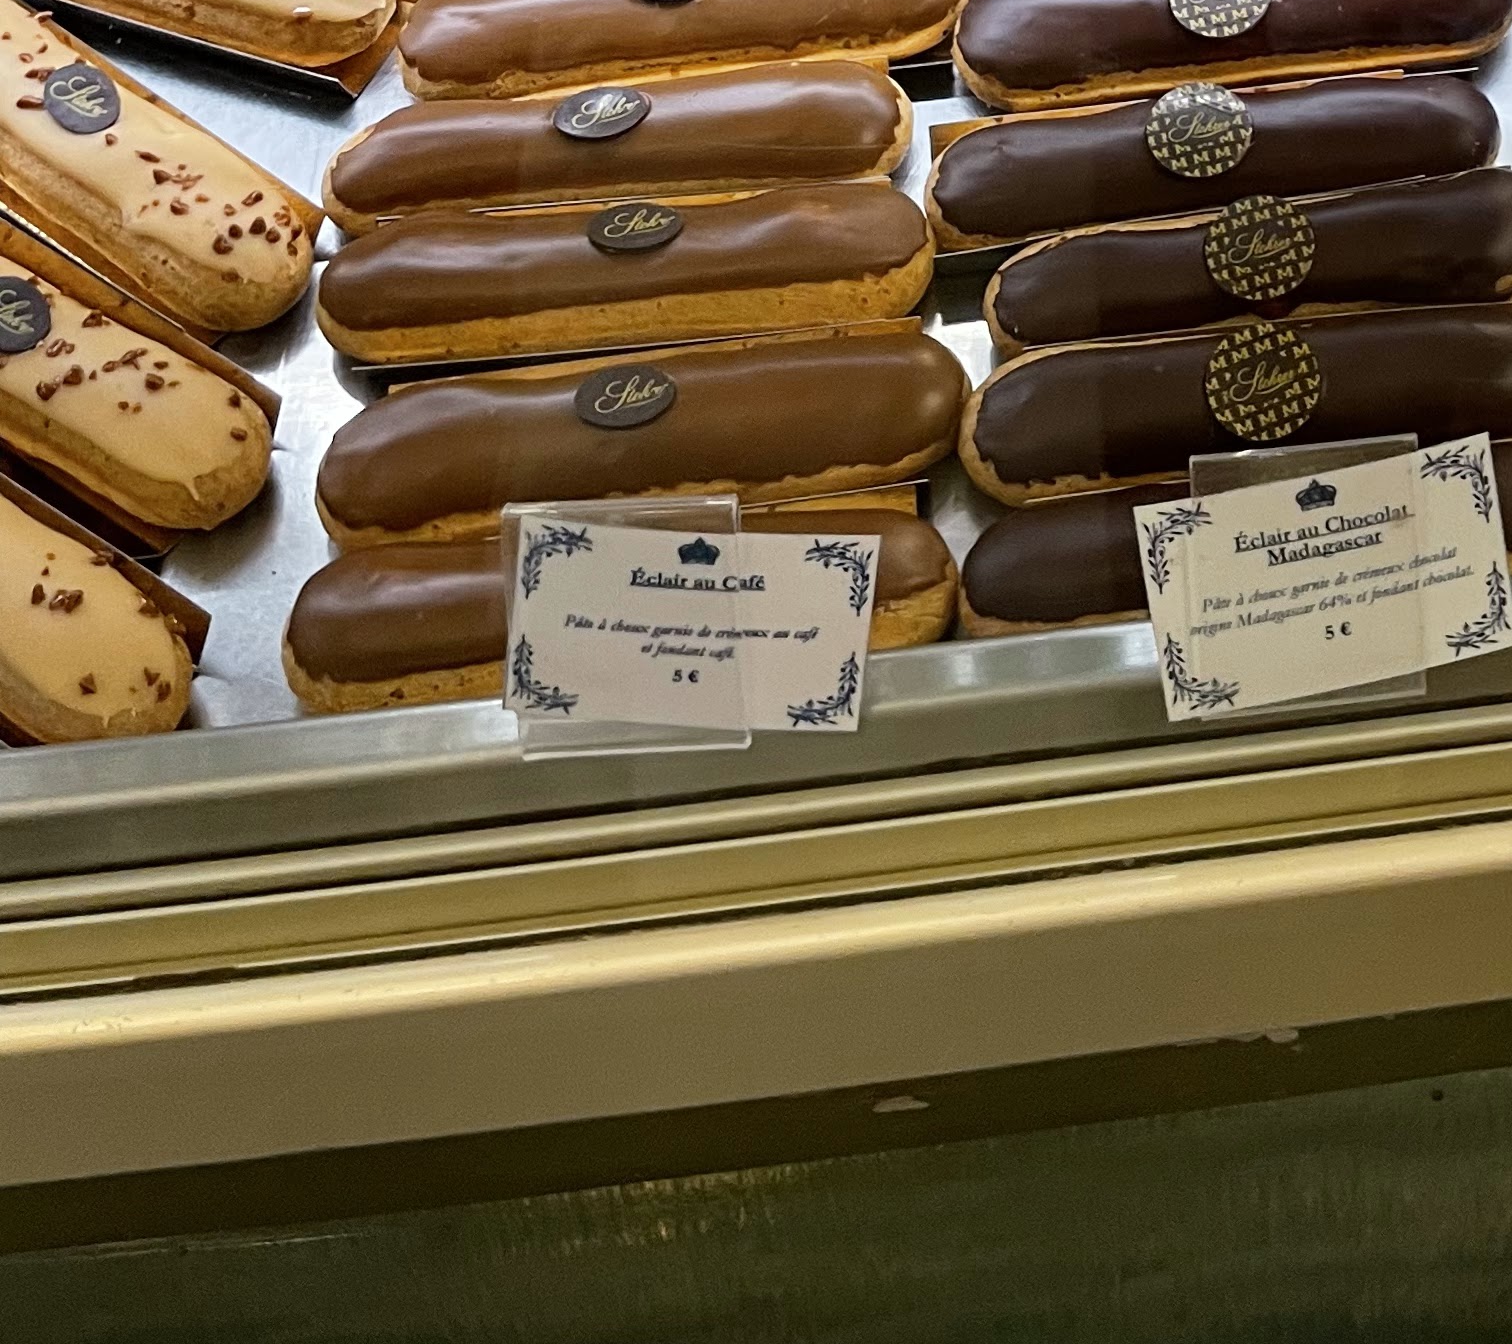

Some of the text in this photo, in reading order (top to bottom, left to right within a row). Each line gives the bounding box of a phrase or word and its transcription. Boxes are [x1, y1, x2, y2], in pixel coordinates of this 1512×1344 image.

[1233, 504, 1410, 553] Éclair au Chocolat
[1266, 530, 1384, 566] Madagascar
[629, 566, 765, 591] Éclair au Café
[1324, 621, 1352, 641] 5 €
[671, 669, 700, 683] 5 €
